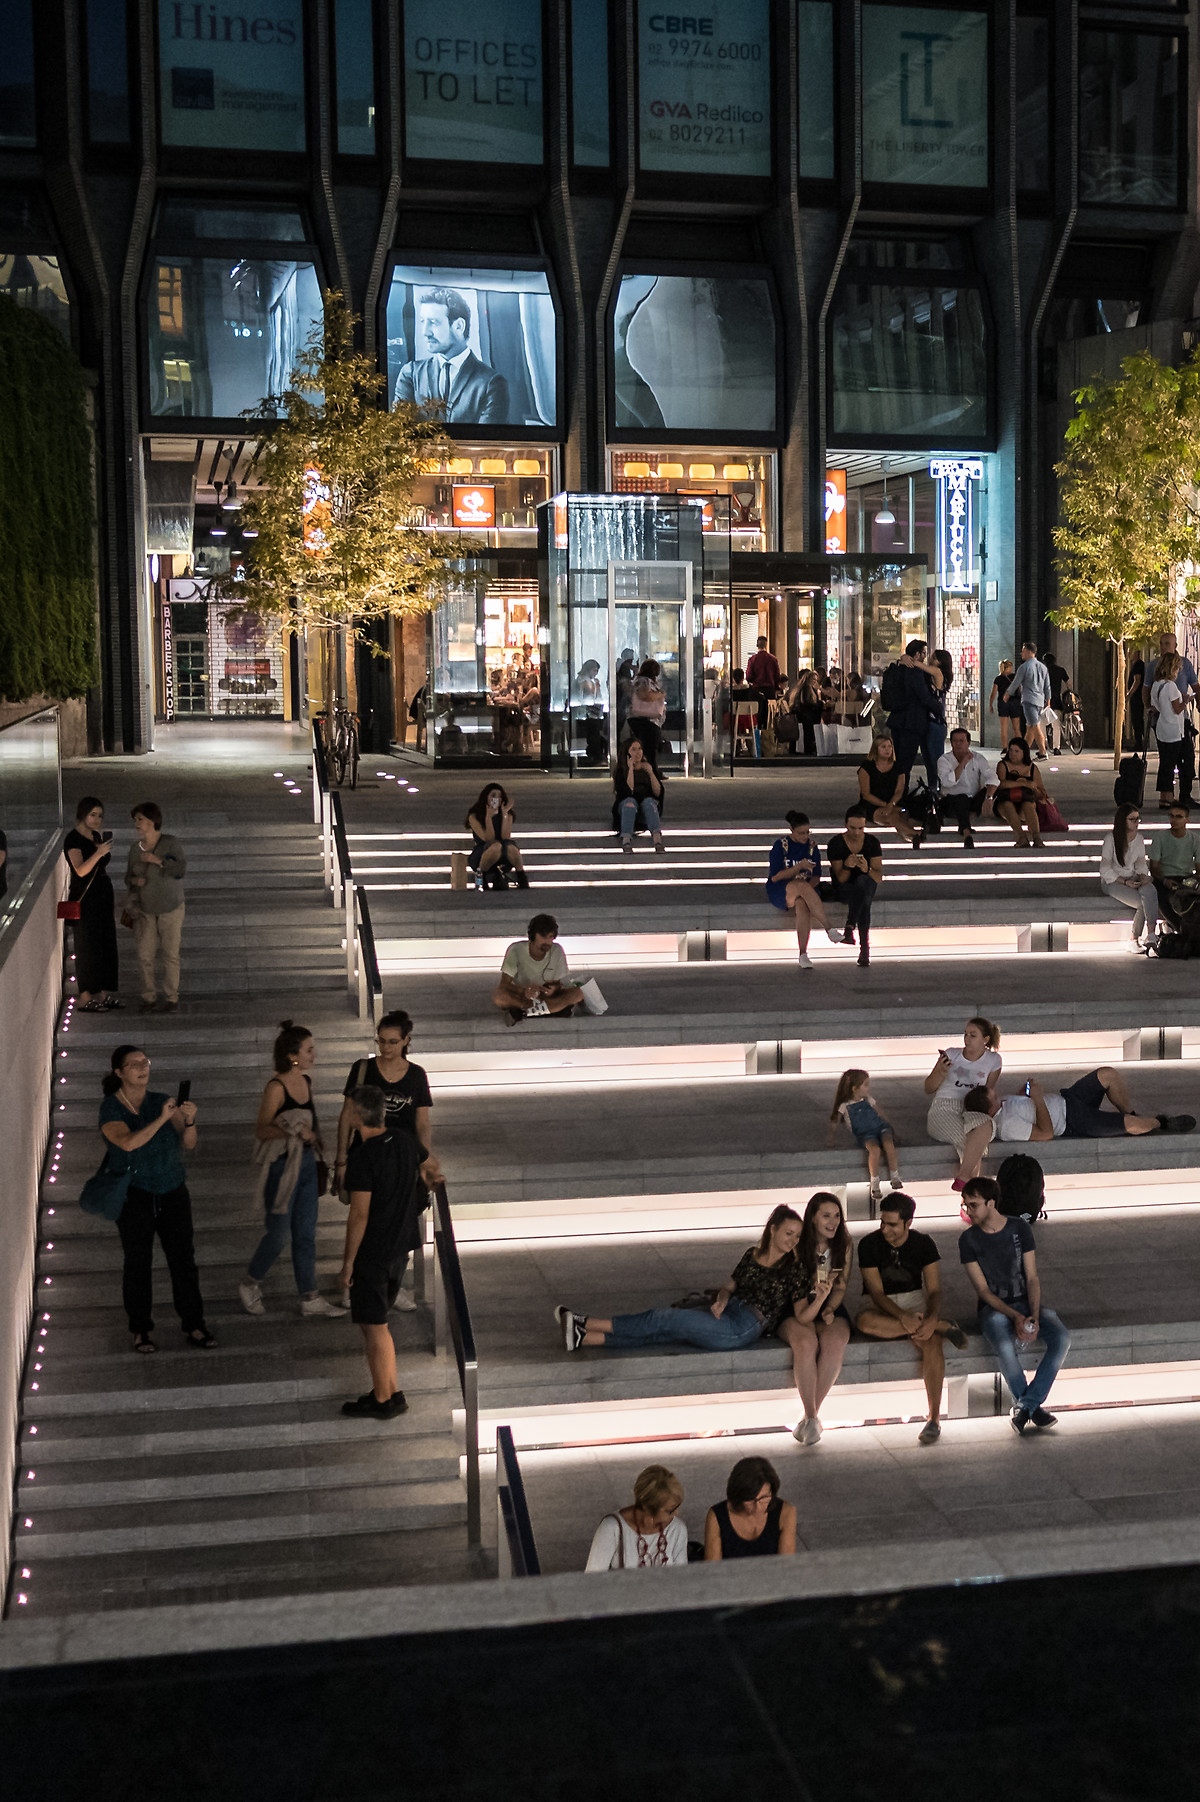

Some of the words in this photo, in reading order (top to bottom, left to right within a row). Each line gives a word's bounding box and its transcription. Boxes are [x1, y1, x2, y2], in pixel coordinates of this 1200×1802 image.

[171, 2, 297, 46] Hines
[648, 14, 714, 36] CBRE
[415, 37, 537, 68] OFFICES
[668, 38, 713, 58] 9974
[717, 42, 762, 62] 6000
[415, 70, 459, 102] TO
[472, 74, 537, 107] LET
[649, 100, 693, 120] GVA
[696, 103, 764, 124] Redilco
[669, 124, 746, 145] 8029211
[869, 139, 893, 152] THE
